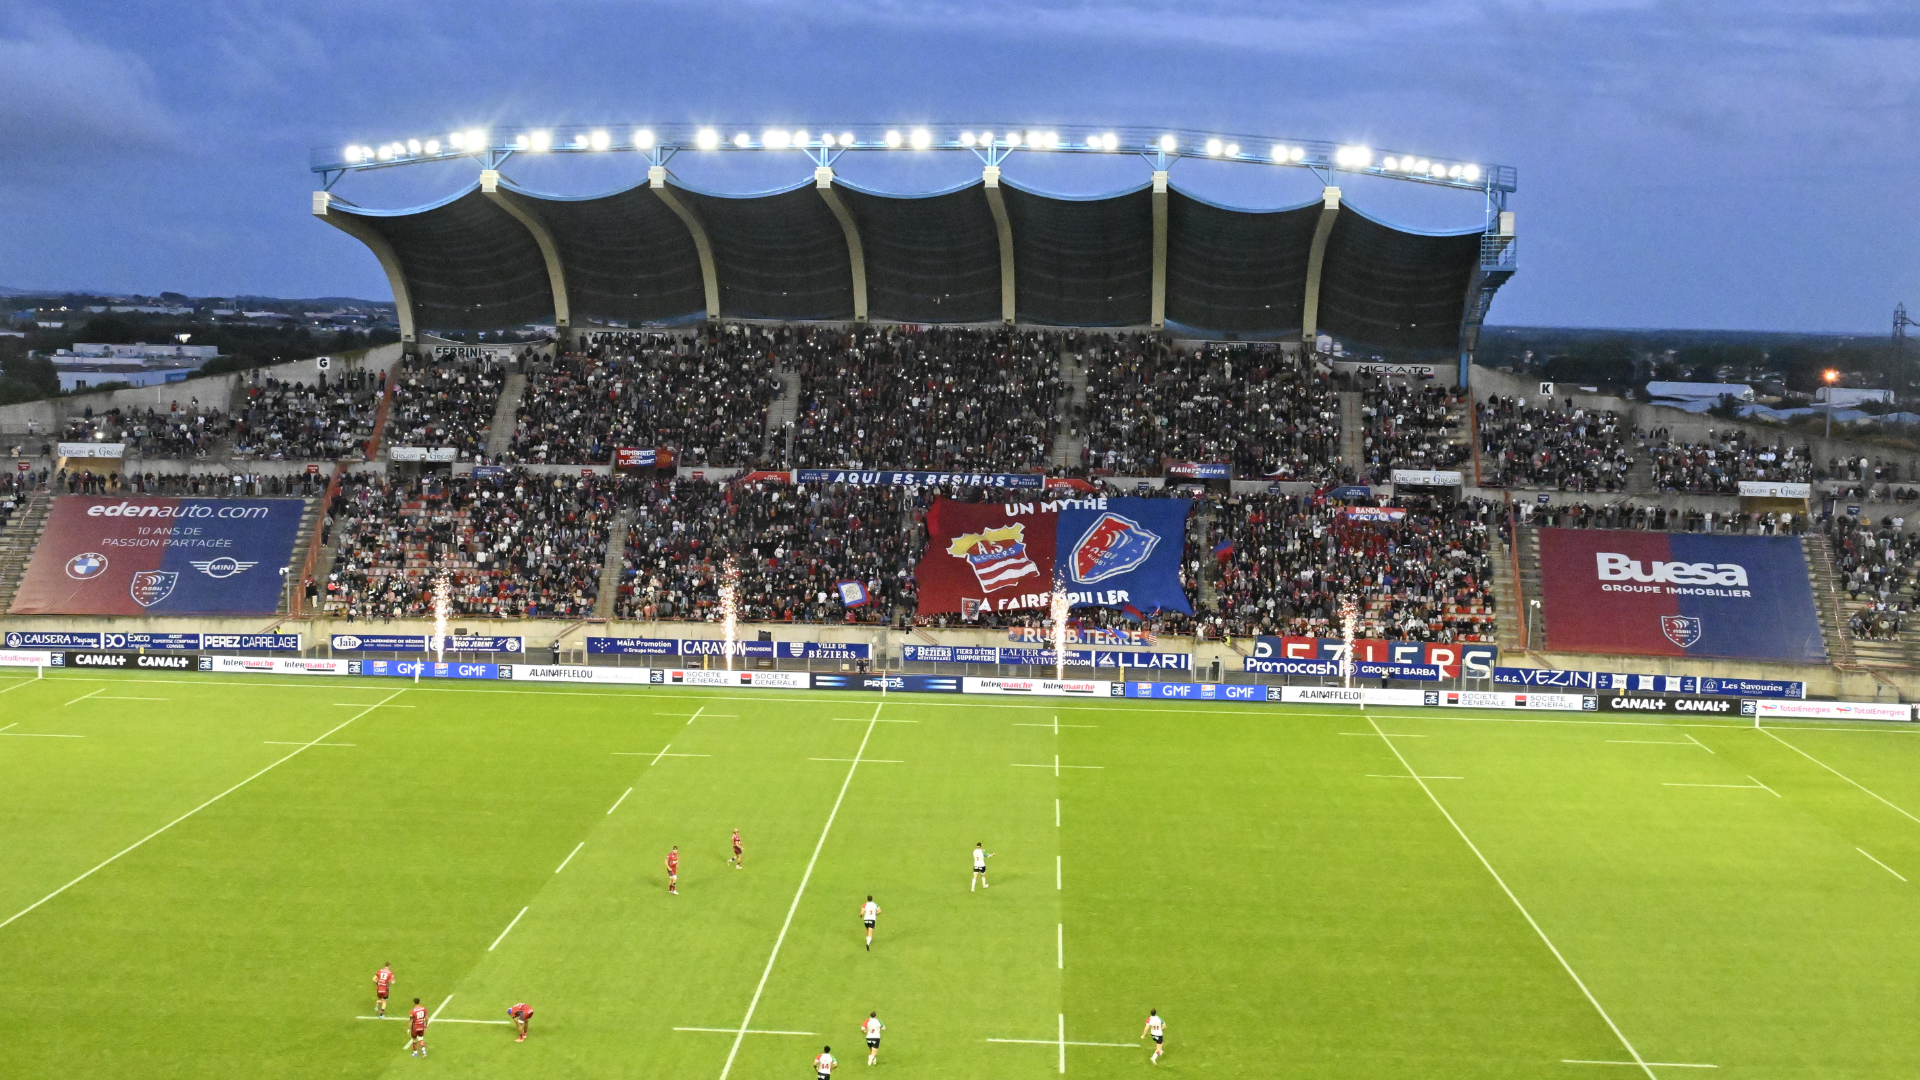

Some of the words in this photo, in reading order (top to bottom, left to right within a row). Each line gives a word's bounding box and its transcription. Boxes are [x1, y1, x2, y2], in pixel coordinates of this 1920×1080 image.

[319, 356, 328, 366] G
[1541, 382, 1551, 394] K
[892, 473, 915, 485] ES
[87, 502, 269, 519] edenauto.com
[1004, 503, 1034, 517] UN
[1041, 498, 1108, 513] MYTHE
[138, 527, 150, 535] 10
[154, 527, 181, 536] ANS
[184, 528, 203, 536] DE
[102, 538, 160, 547] PASSION
[163, 538, 234, 548] PARTAGÉE
[210, 564, 235, 572] MINI
[1596, 552, 1749, 587] Buesa
[1601, 584, 1662, 594] GROUPE
[1666, 587, 1752, 598] IMMOBILIER
[999, 592, 1050, 610] FAIRE
[24, 633, 71, 645] CAUSERA
[73, 636, 98, 646] Paysage
[204, 635, 241, 648] PEREZ
[242, 636, 297, 649] CARRELAGE
[636, 641, 672, 649] Promotion
[808, 649, 856, 659] BÉZIERS
[974, 648, 996, 656] D'ÊTRE
[75, 655, 127, 666] CANAL+
[137, 656, 189, 668] CANAL+
[458, 665, 486, 676] GMF
[1246, 658, 1338, 676] Promocash
[1403, 667, 1437, 676] BARBA
[1519, 669, 1592, 688] VEZIN
[1162, 685, 1191, 696] GMF
[1226, 686, 1255, 698] GMF
[1721, 680, 1738, 689] Les
[1740, 681, 1783, 692] Savouries
[1611, 698, 1667, 710] CANAL+
[1674, 700, 1731, 712] CANAL+
[1780, 705, 1830, 714] TotalEnergies
[1854, 707, 1905, 717] TotalEnergies
[416, 1011, 425, 1020] 10
